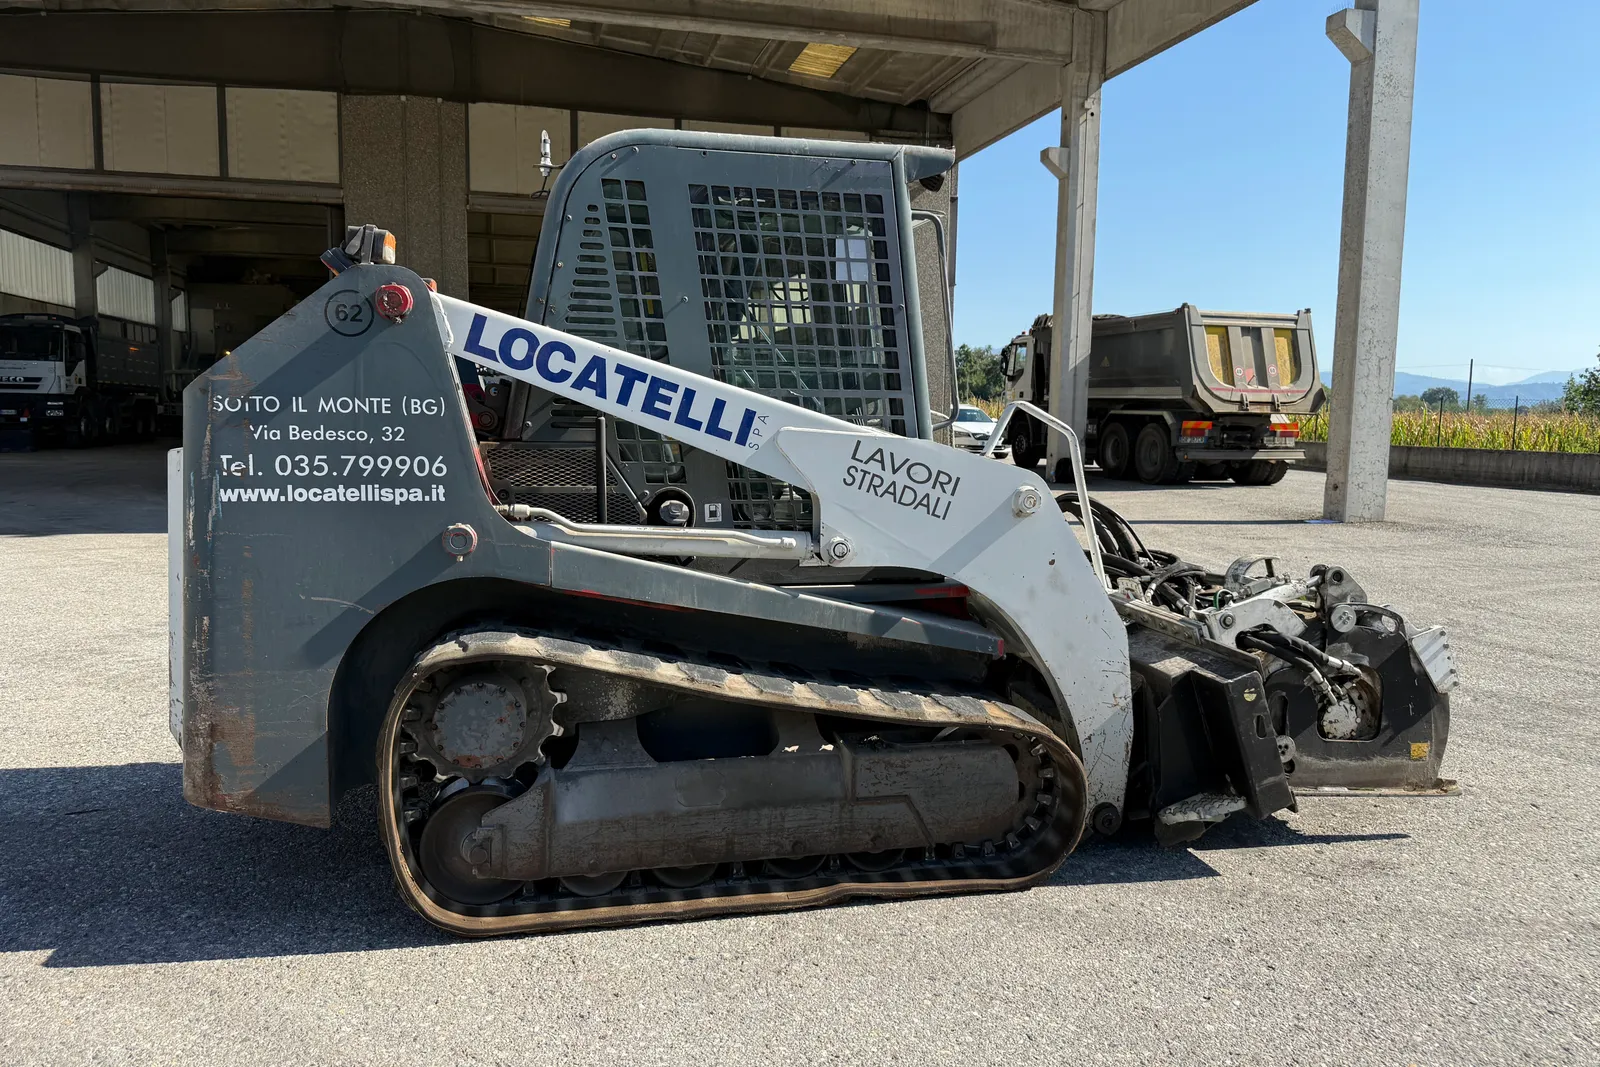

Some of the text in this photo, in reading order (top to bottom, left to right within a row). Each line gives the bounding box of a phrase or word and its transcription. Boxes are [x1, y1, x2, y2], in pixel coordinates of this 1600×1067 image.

[334, 303, 364, 323] 62
[463, 312, 757, 447] LOCATELLI
[292, 396, 308, 413] IL
[317, 396, 392, 414] MONTE
[402, 396, 446, 416] (BG)
[249, 424, 405, 444] Via Bedesco, 32
[220, 454, 448, 477] Tel. 035.799906
[850, 439, 961, 497] LAVORI
[218, 484, 446, 505] www.locatellispa.it
[842, 466, 952, 521] STRADALI
